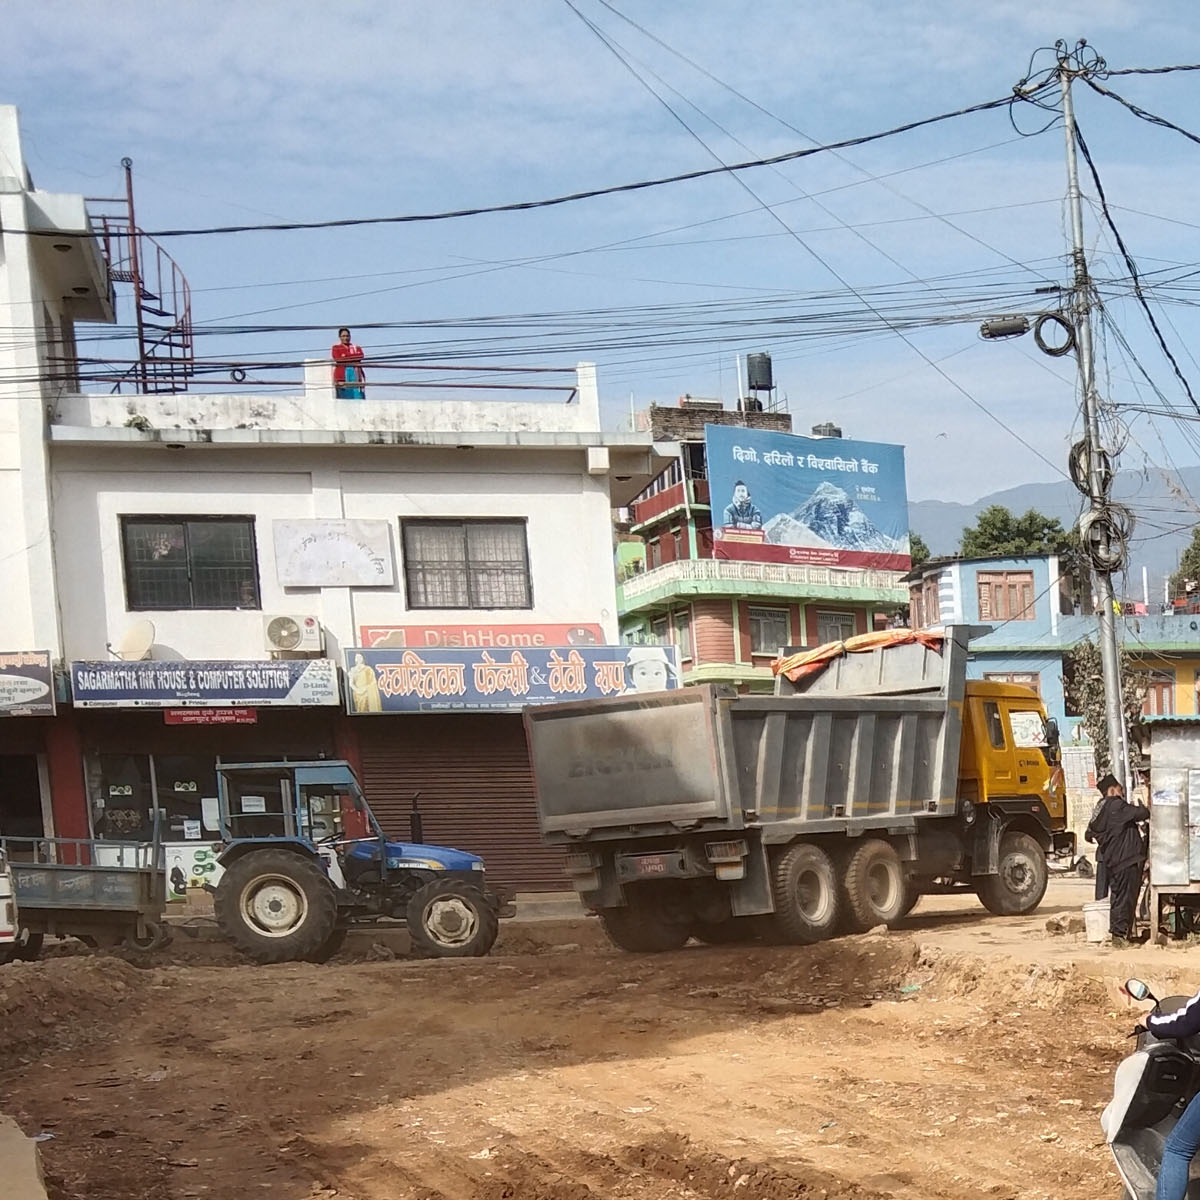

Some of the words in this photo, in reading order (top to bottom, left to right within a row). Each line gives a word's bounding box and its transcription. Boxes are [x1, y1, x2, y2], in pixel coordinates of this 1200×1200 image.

[733, 445, 760, 464] दिगो,
[763, 450, 794, 466] दरिलो
[797, 456, 805, 468] र
[424, 630, 546, 647] DishHome
[78, 671, 138, 690] SAGARMATHA
[139, 671, 155, 689] INK
[157, 671, 187, 689] HOUSE
[189, 671, 196, 689] &
[198, 670, 246, 689] COMPUTER
[246, 670, 290, 688] SOLUTION
[530, 666, 548, 685] &
